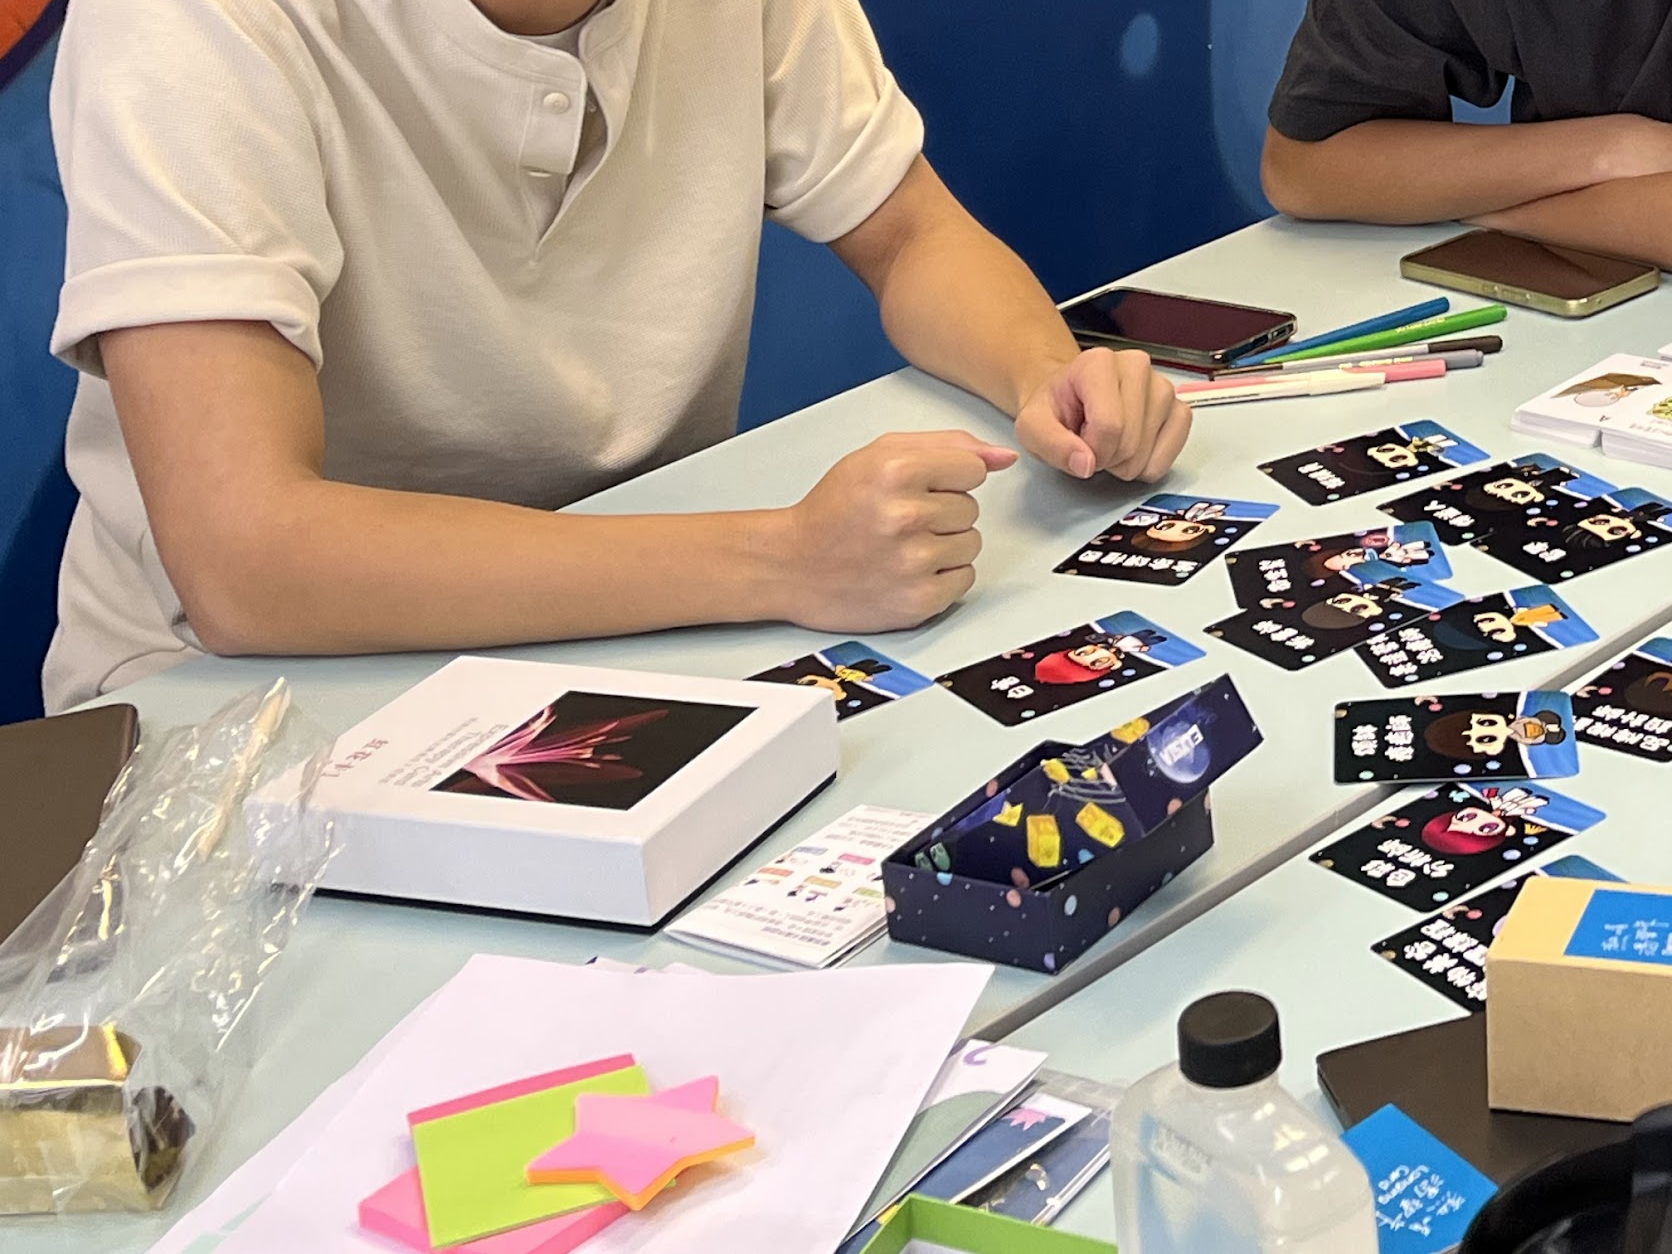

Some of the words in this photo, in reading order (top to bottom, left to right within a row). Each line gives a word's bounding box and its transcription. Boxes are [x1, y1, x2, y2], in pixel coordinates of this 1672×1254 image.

[1360, 860, 1416, 887] 色彩
[1377, 839, 1454, 878] 分析師
